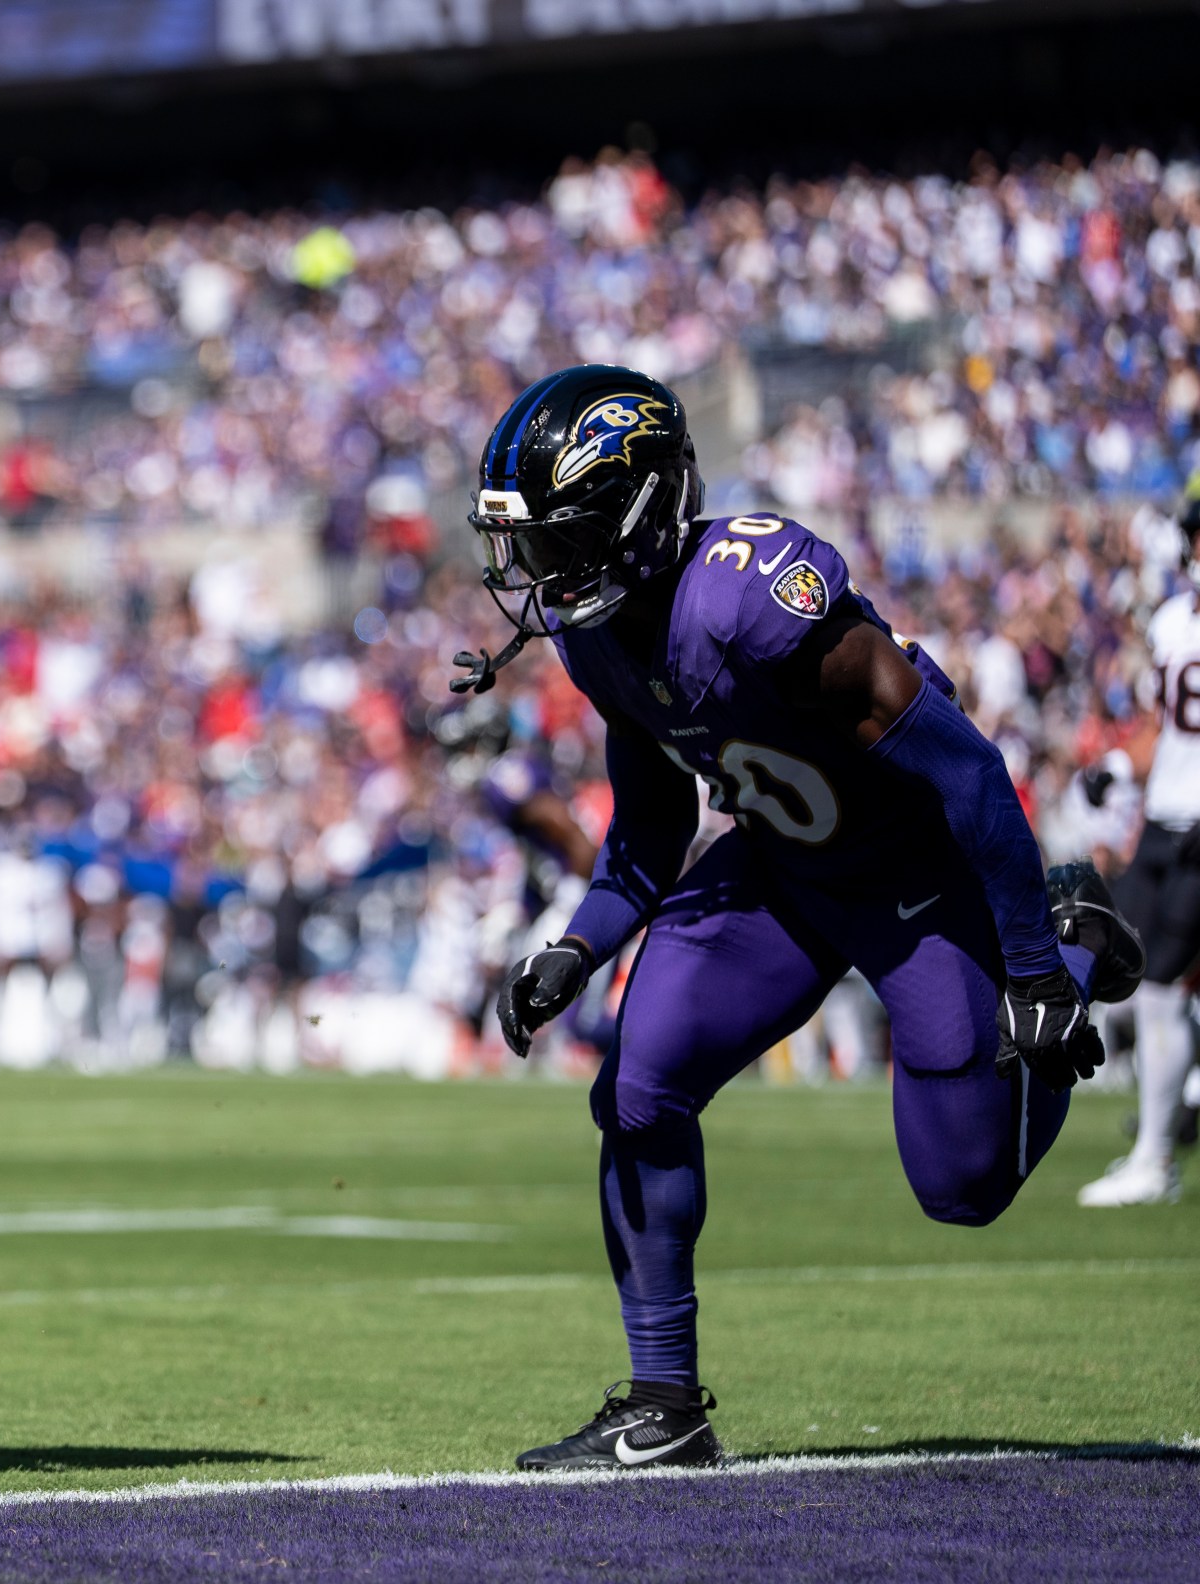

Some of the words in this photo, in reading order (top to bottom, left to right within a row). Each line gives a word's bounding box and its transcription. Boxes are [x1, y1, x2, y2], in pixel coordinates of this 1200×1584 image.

[705, 517, 785, 571] 30
[776, 565, 805, 593] RAVENS
[669, 725, 710, 737] RAVENS
